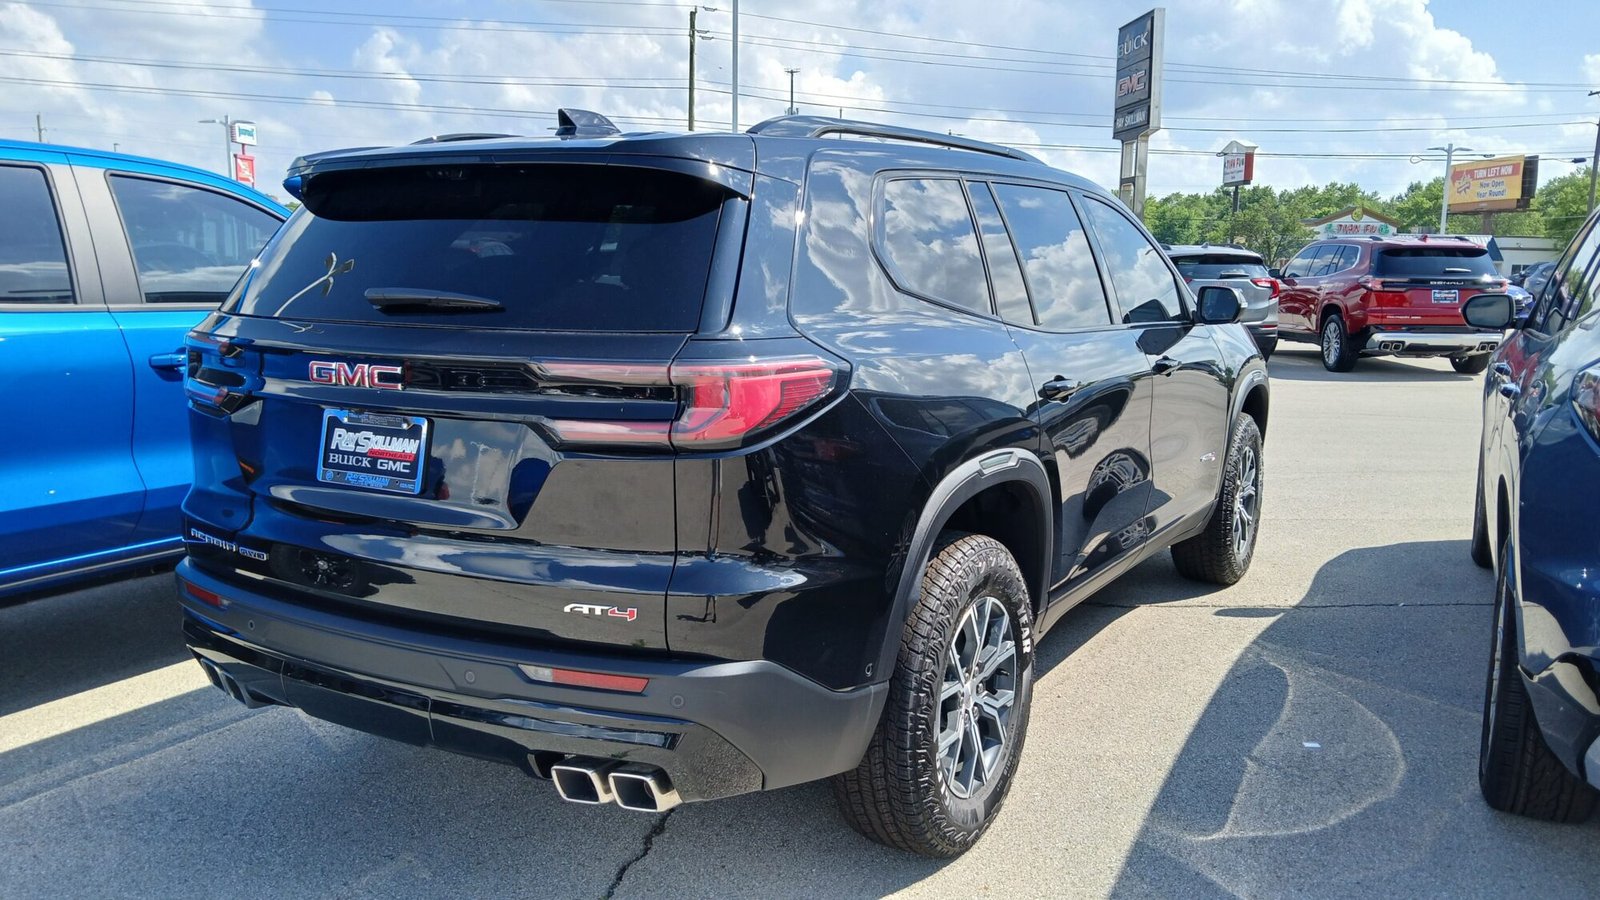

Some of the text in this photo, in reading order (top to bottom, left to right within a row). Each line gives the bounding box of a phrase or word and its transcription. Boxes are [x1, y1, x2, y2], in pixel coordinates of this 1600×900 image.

[1118, 31, 1148, 57] BUICK
[1118, 70, 1145, 97] GMC
[1474, 165, 1513, 179] TURN LEFT NOW
[1491, 180, 1504, 188] Open
[309, 360, 402, 391] GMC
[328, 453, 411, 473] BUICK GMC
[369, 449, 413, 461] NORTHEAST
[563, 603, 638, 622] AT4
